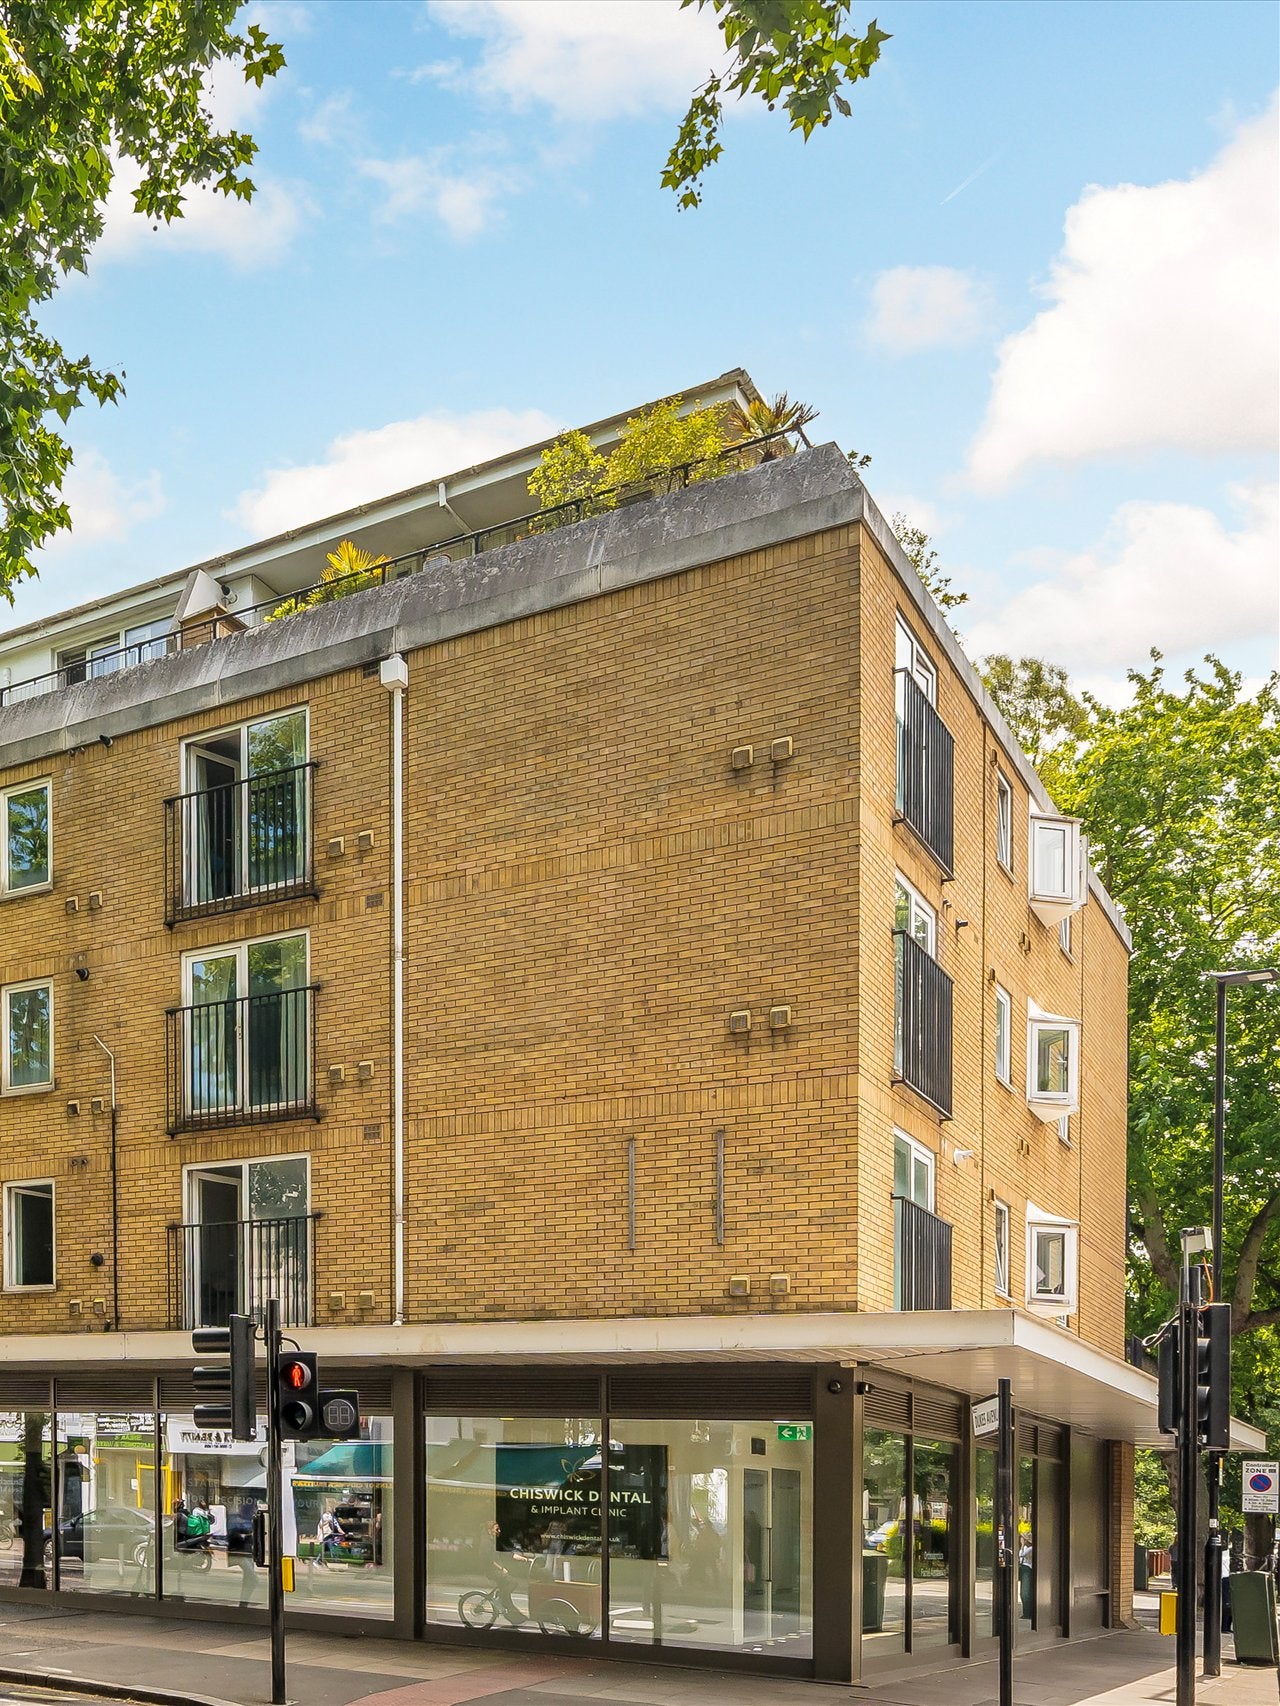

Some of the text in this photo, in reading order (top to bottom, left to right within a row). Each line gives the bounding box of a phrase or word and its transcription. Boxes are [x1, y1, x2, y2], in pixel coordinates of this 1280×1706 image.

[509, 1488, 651, 1504] CHISWICK DNTAL
[530, 1504, 627, 1518] & IMPLANT CLNIC
